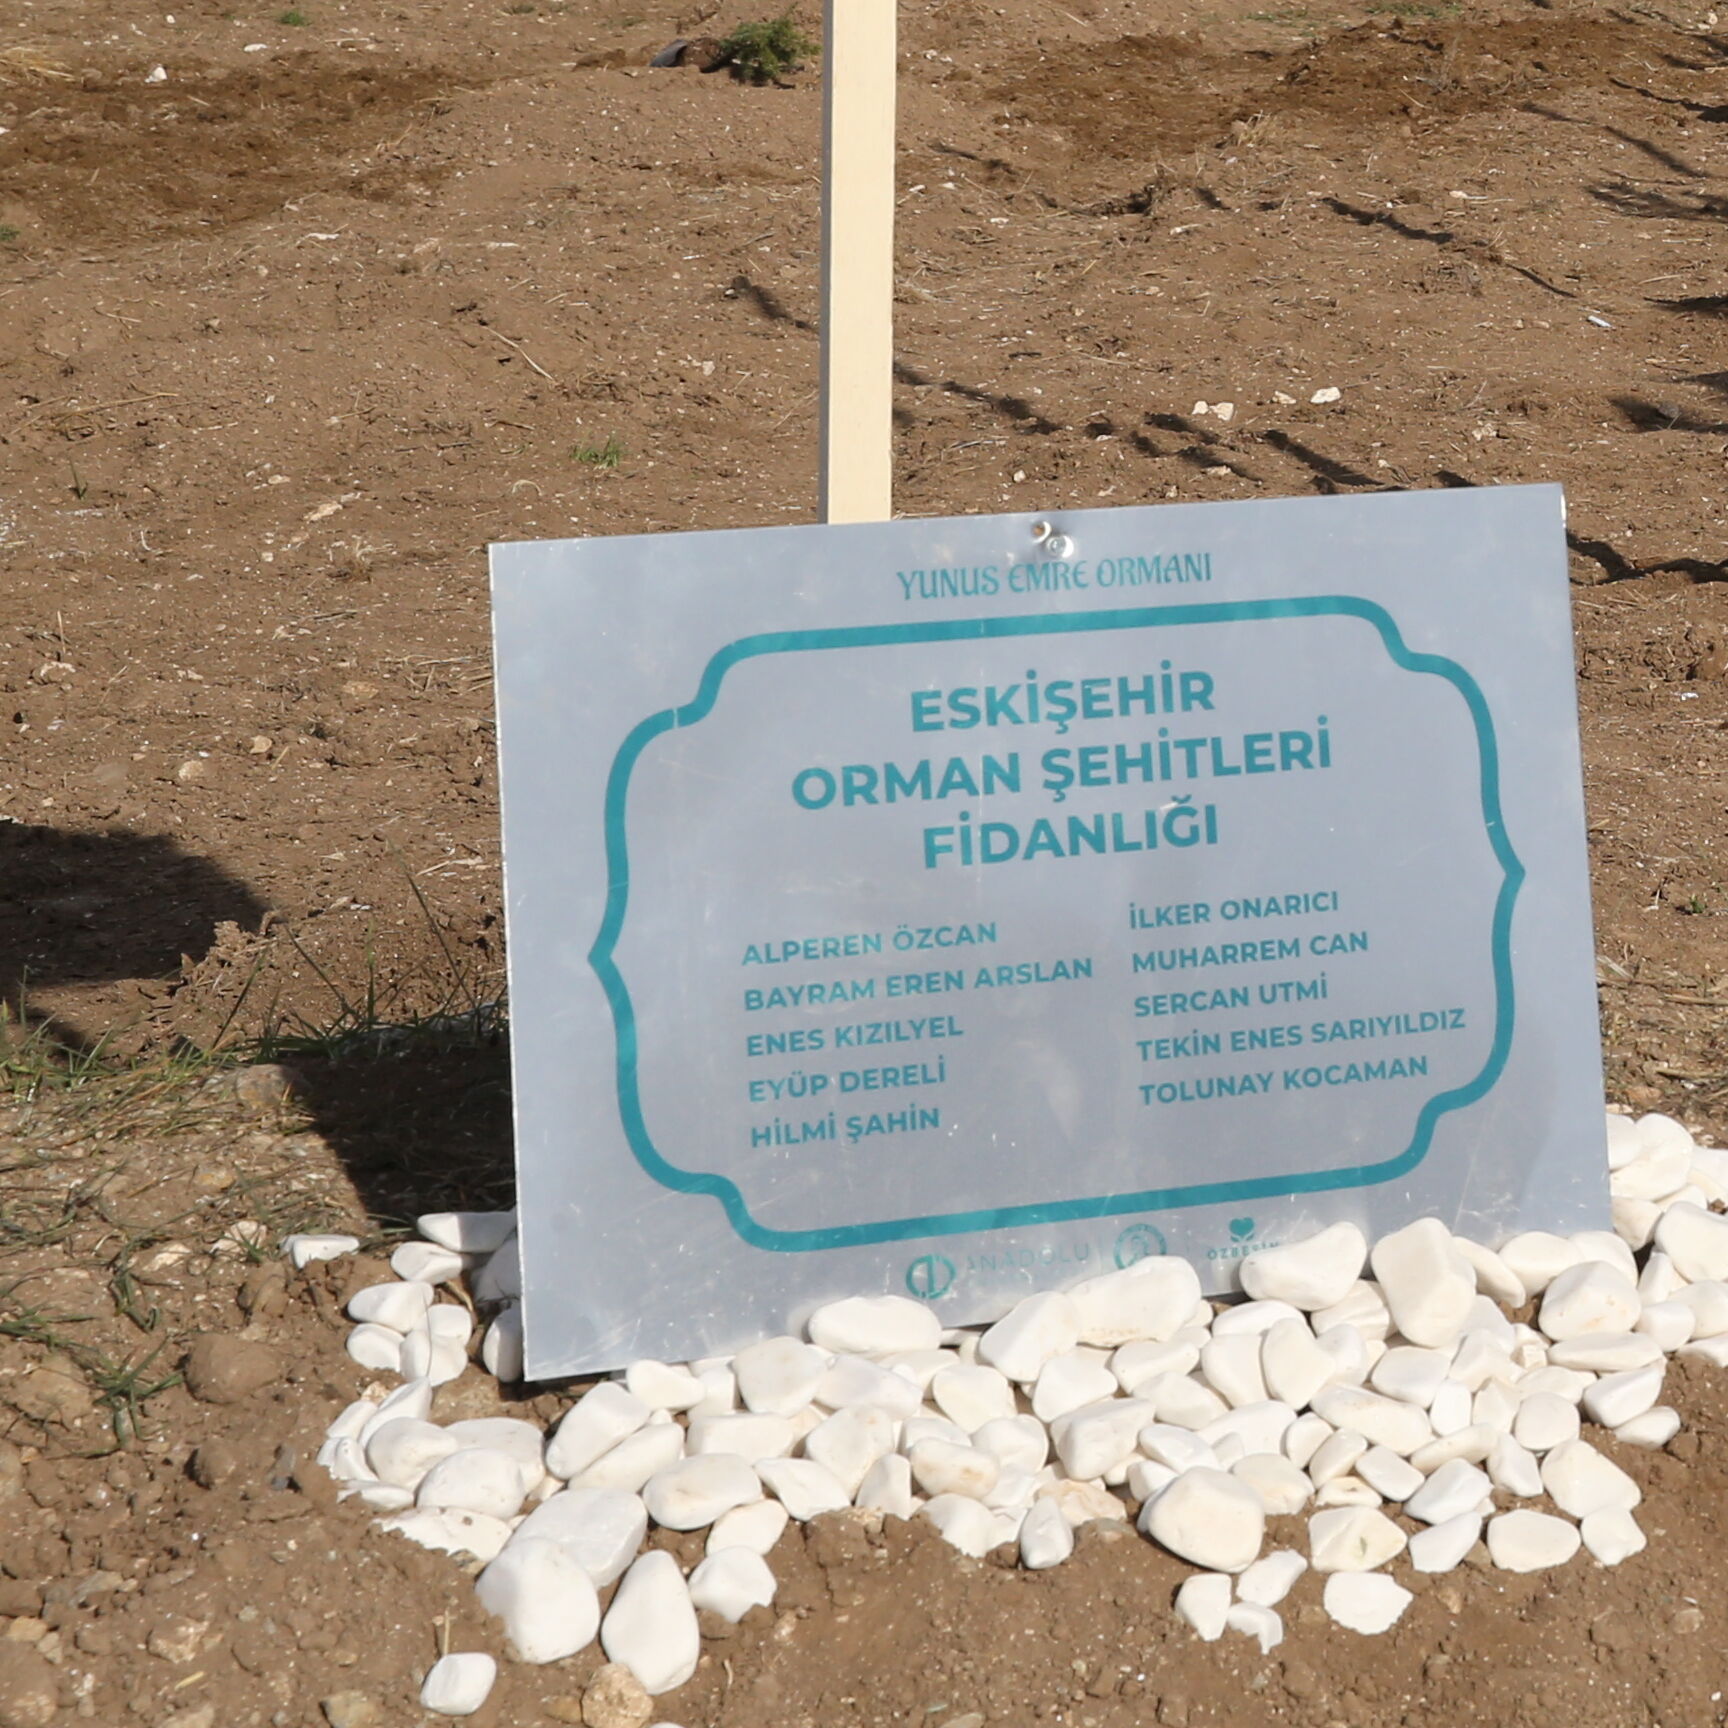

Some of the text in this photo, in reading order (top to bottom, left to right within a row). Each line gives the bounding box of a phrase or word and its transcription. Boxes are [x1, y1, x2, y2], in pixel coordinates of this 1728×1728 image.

[896, 552, 1213, 600] YUNUS EMRE ORMANI
[911, 660, 1215, 732] ESKİŞEHİR
[792, 714, 1332, 810] ORMAN ŞEHİTLERİ
[924, 795, 1218, 868] FİDANLIĞI
[1130, 891, 1340, 929] İLKER ONARICI
[741, 922, 999, 966] ALPEREN ÖZCAN
[1132, 932, 1370, 972] MUHARREM CAN
[744, 959, 1094, 1011] BAYRAM EREN ARSLAN
[1135, 974, 1329, 1017] SERCAN UTMİ
[746, 1016, 965, 1056] ENES KIZILYEL
[1136, 1008, 1467, 1060] TEKİN ENES SARIYILDIZ
[748, 1056, 947, 1102] EYÜP DERELİ
[1138, 1056, 1430, 1105] TOLUNAY KOCAMAN
[751, 1104, 941, 1148] HİLMİ ŞAHİN
